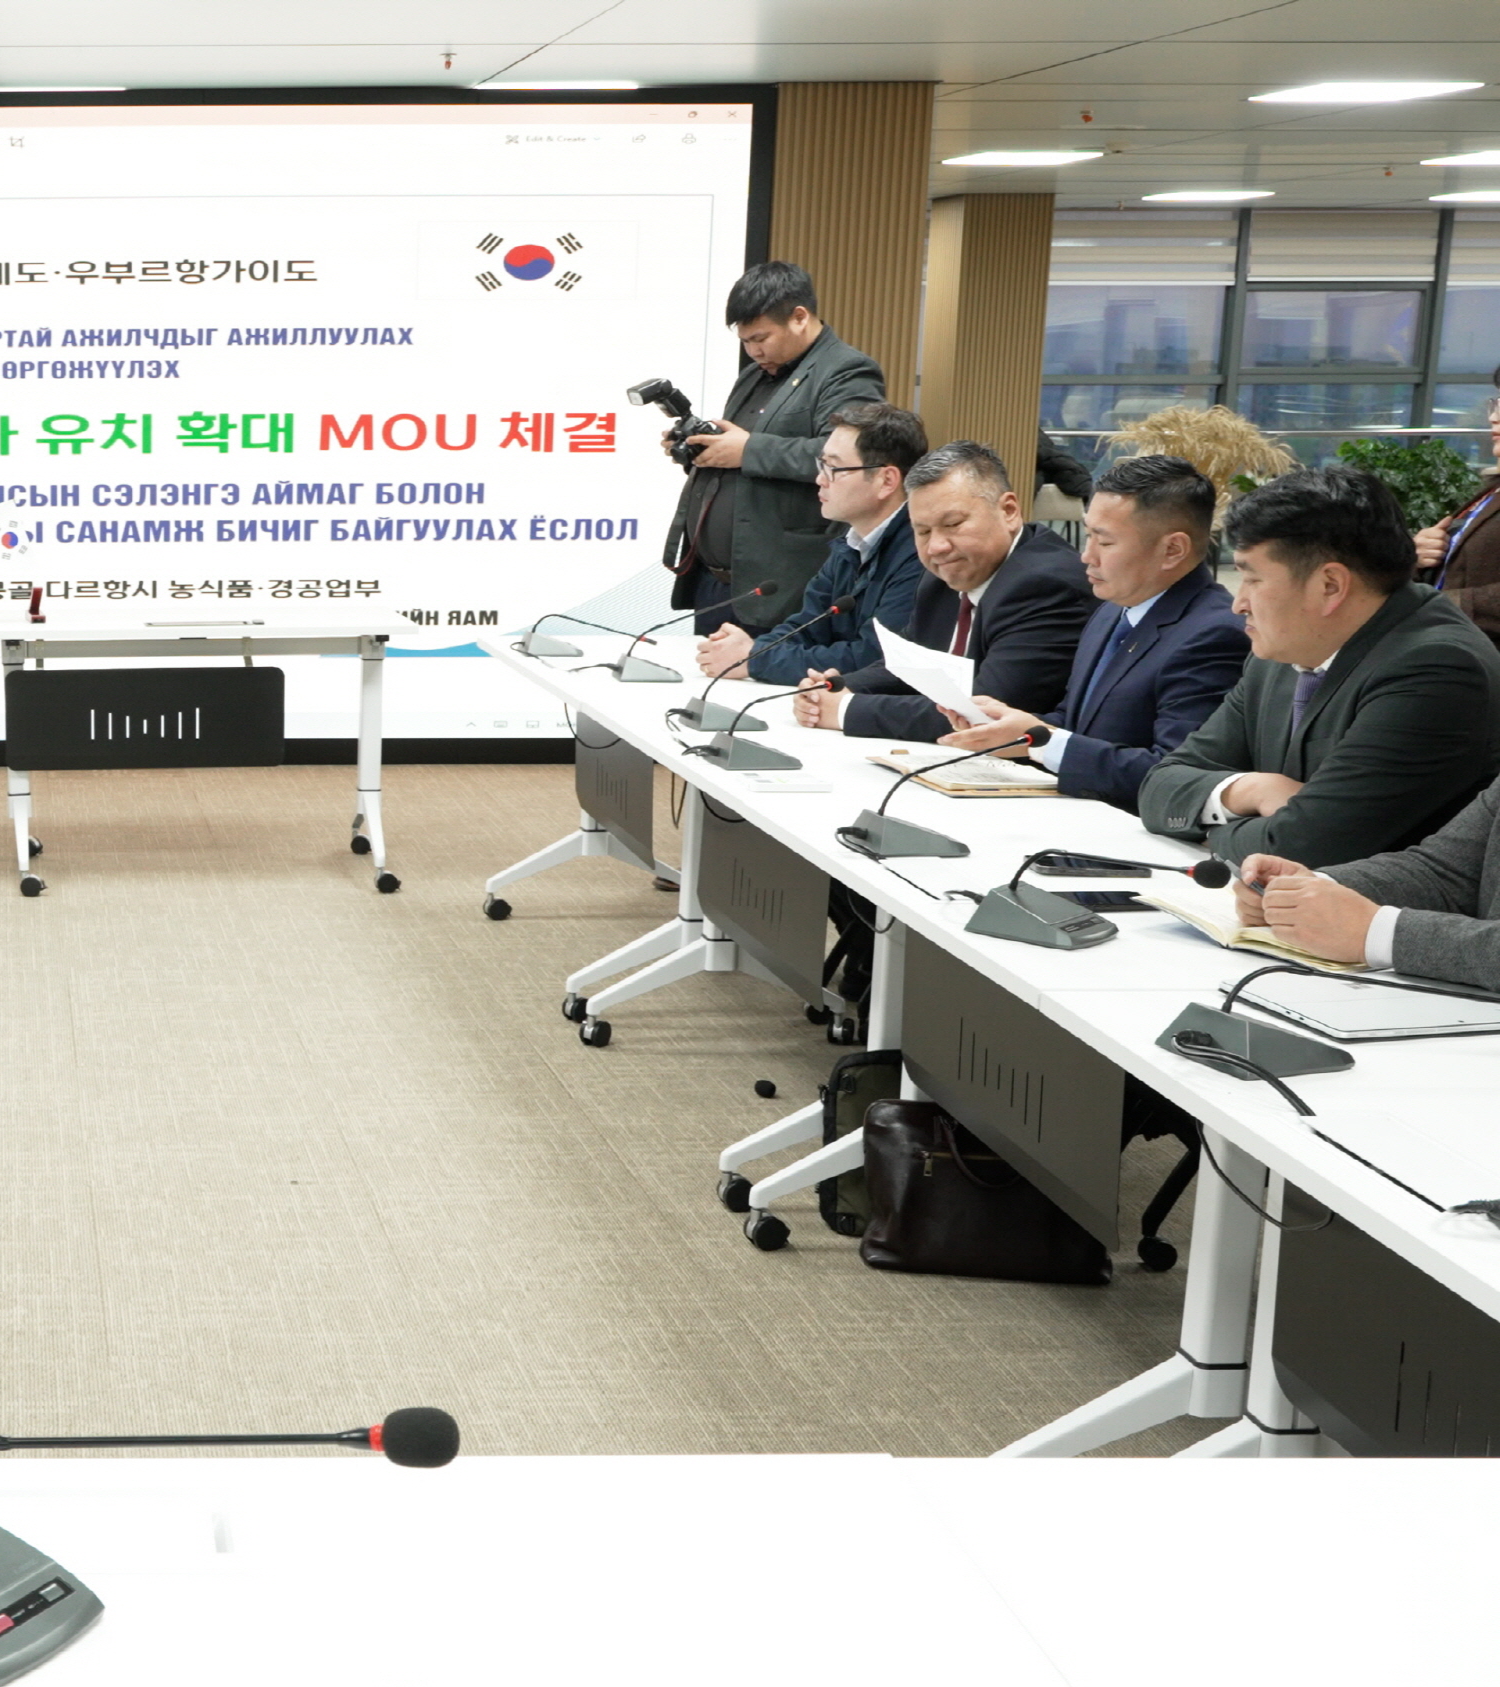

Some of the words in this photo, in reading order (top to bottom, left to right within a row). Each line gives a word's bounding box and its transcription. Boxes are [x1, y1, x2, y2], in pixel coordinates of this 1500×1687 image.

[61, 328, 219, 351] АЖИЛЧДЫГ
[227, 327, 413, 348] АЖИЛЛУУЛАХ
[2, 359, 180, 381] ӨРГӨЖҮҮЛЭХ
[35, 412, 153, 457] 유치
[176, 410, 294, 455] 확대
[319, 413, 477, 452] MOU
[499, 411, 617, 455] 체결
[92, 483, 240, 507] СЭЛЭНГЭ
[252, 480, 365, 506] АЙМАГ
[375, 482, 485, 505] БОЛОН
[56, 519, 204, 545] САНАМЖ
[216, 519, 319, 542] БИЧИГ
[330, 516, 517, 542] БАЙГУУЛАХ
[529, 515, 638, 541] ЁСЛОЛ
[45, 580, 158, 600] 다르항시
[168, 579, 382, 600] 농식품·경공업부
[447, 609, 499, 626] ЯАМ
